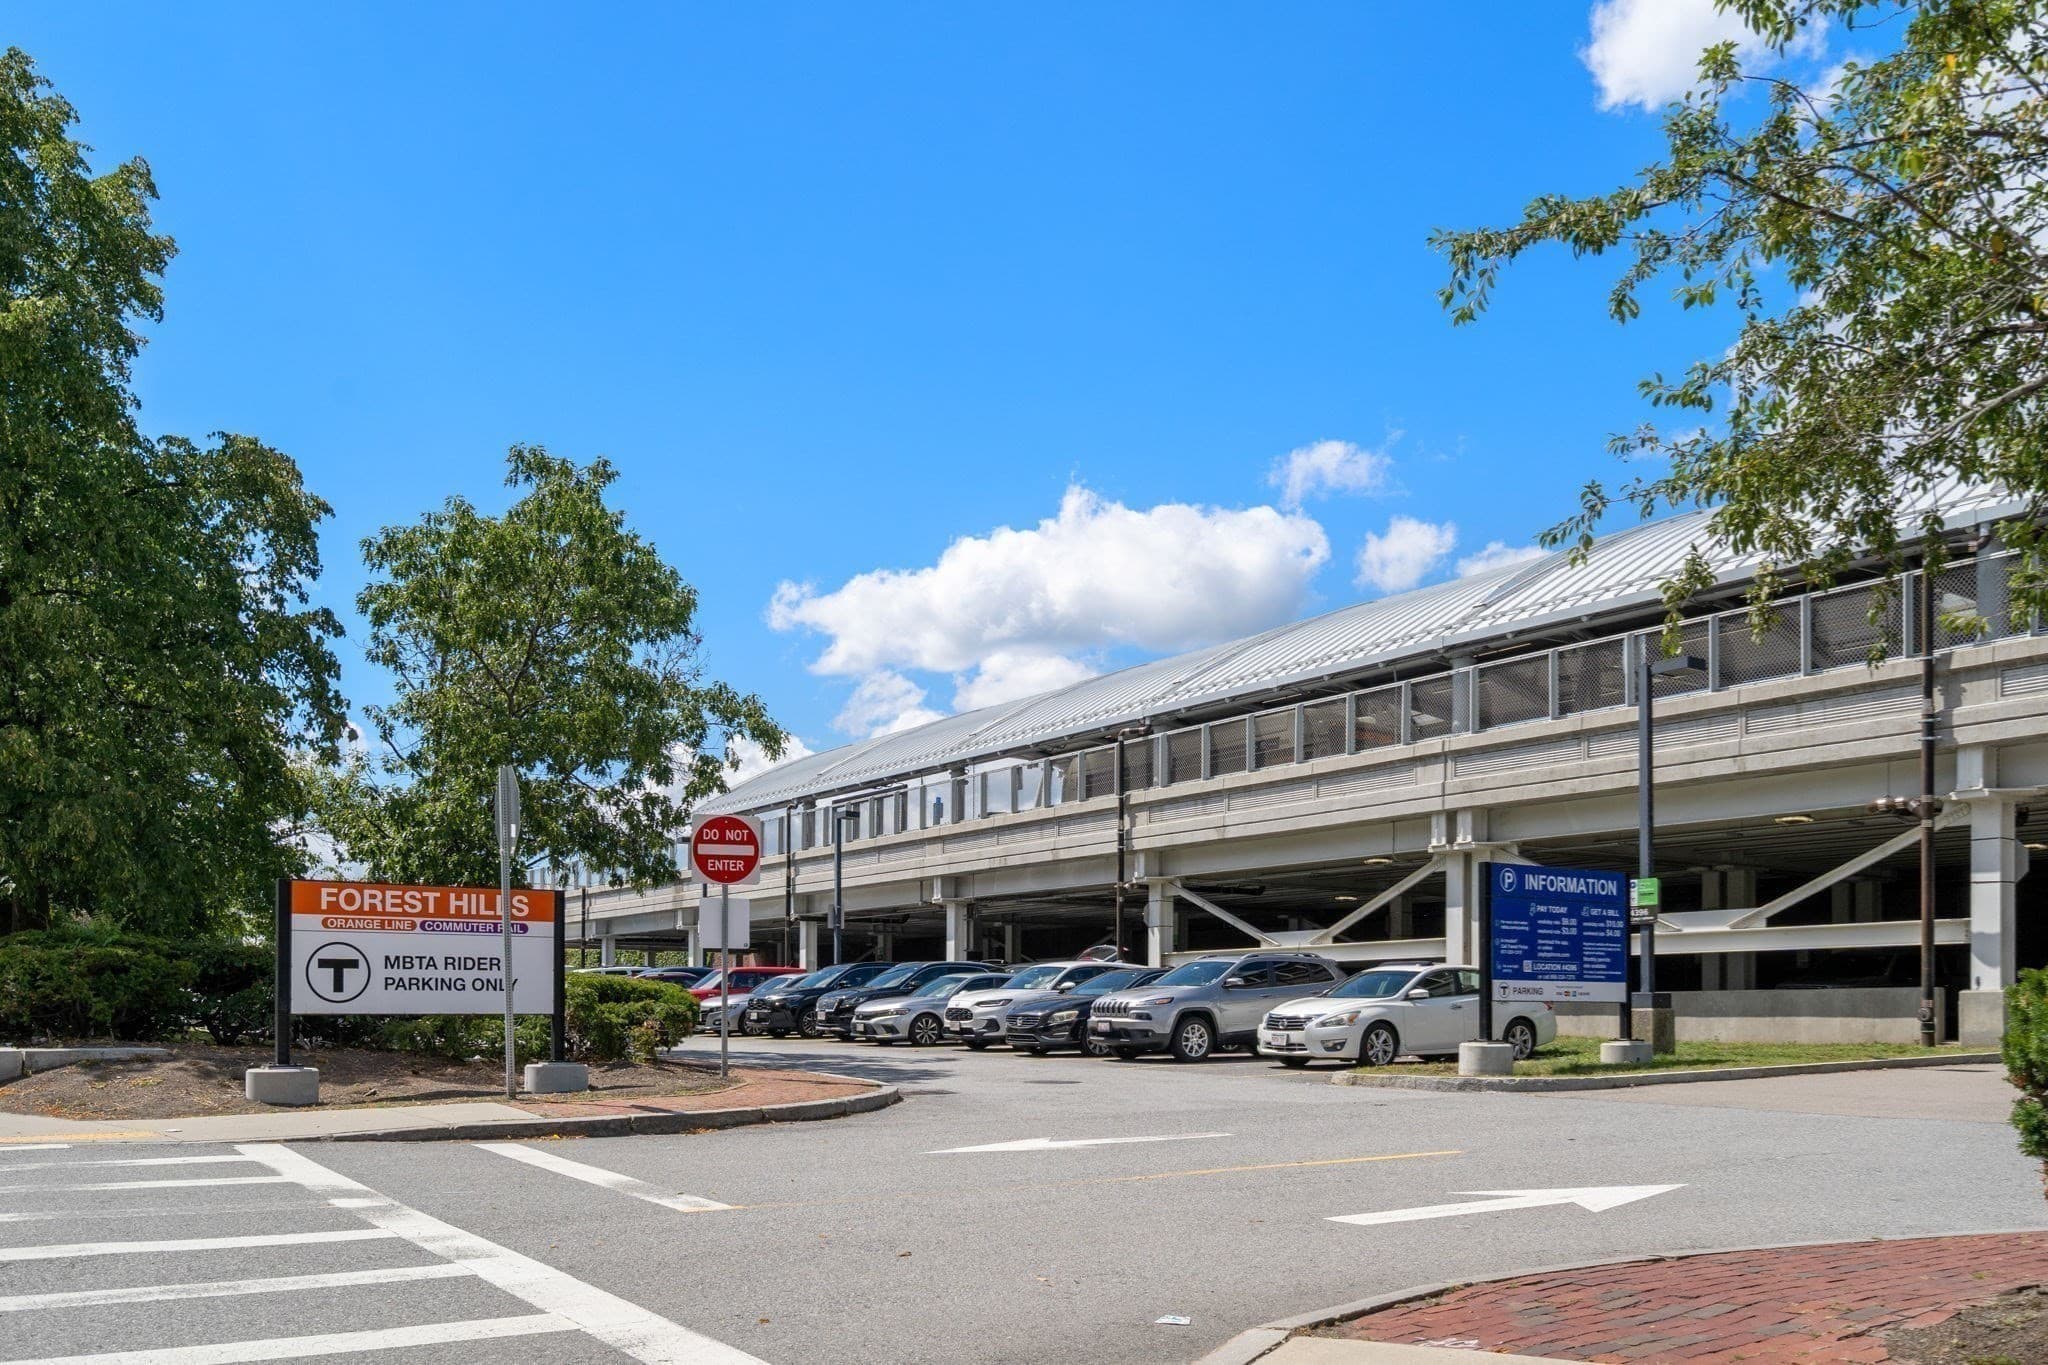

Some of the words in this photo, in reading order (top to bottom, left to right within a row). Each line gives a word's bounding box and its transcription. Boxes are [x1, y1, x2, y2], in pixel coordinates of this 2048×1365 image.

[703, 828, 719, 840] DO
[725, 829, 749, 841] NOT
[707, 859, 744, 871] ENTER
[1525, 873, 1617, 896] INFORMATION
[320, 887, 440, 914] FOREST
[450, 893, 530, 917] HILLS
[1536, 905, 1547, 913] PAY
[1549, 905, 1568, 914] TODAY
[1590, 908, 1601, 916] GET
[1607, 909, 1620, 917] BILL
[327, 918, 382, 930] ORANGE
[385, 919, 412, 931] LINE
[424, 920, 494, 933] COMMUTER
[384, 955, 438, 970] MBTA
[444, 956, 501, 971] RIDER
[1533, 963, 1561, 971] LOCATION
[384, 977, 466, 991] PARKING
[1513, 986, 1544, 996] PARKING
